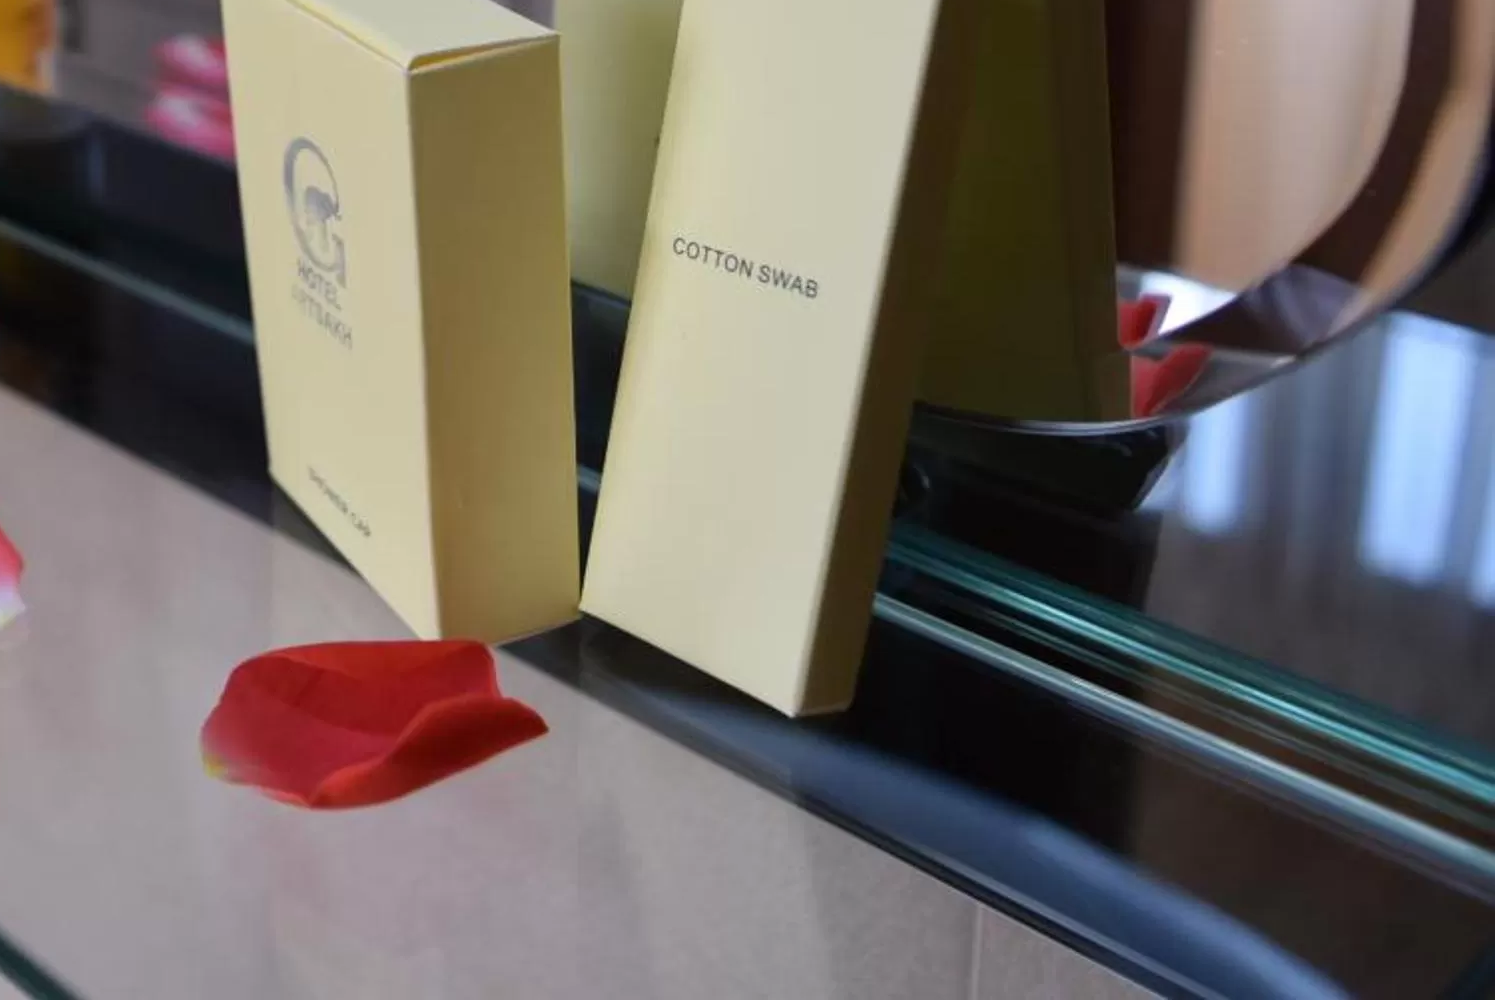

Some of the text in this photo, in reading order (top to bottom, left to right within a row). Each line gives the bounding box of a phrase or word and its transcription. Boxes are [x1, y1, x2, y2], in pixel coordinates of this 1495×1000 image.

[296, 257, 343, 311] HOTEL
[672, 237, 819, 299] COTTON SWAB
